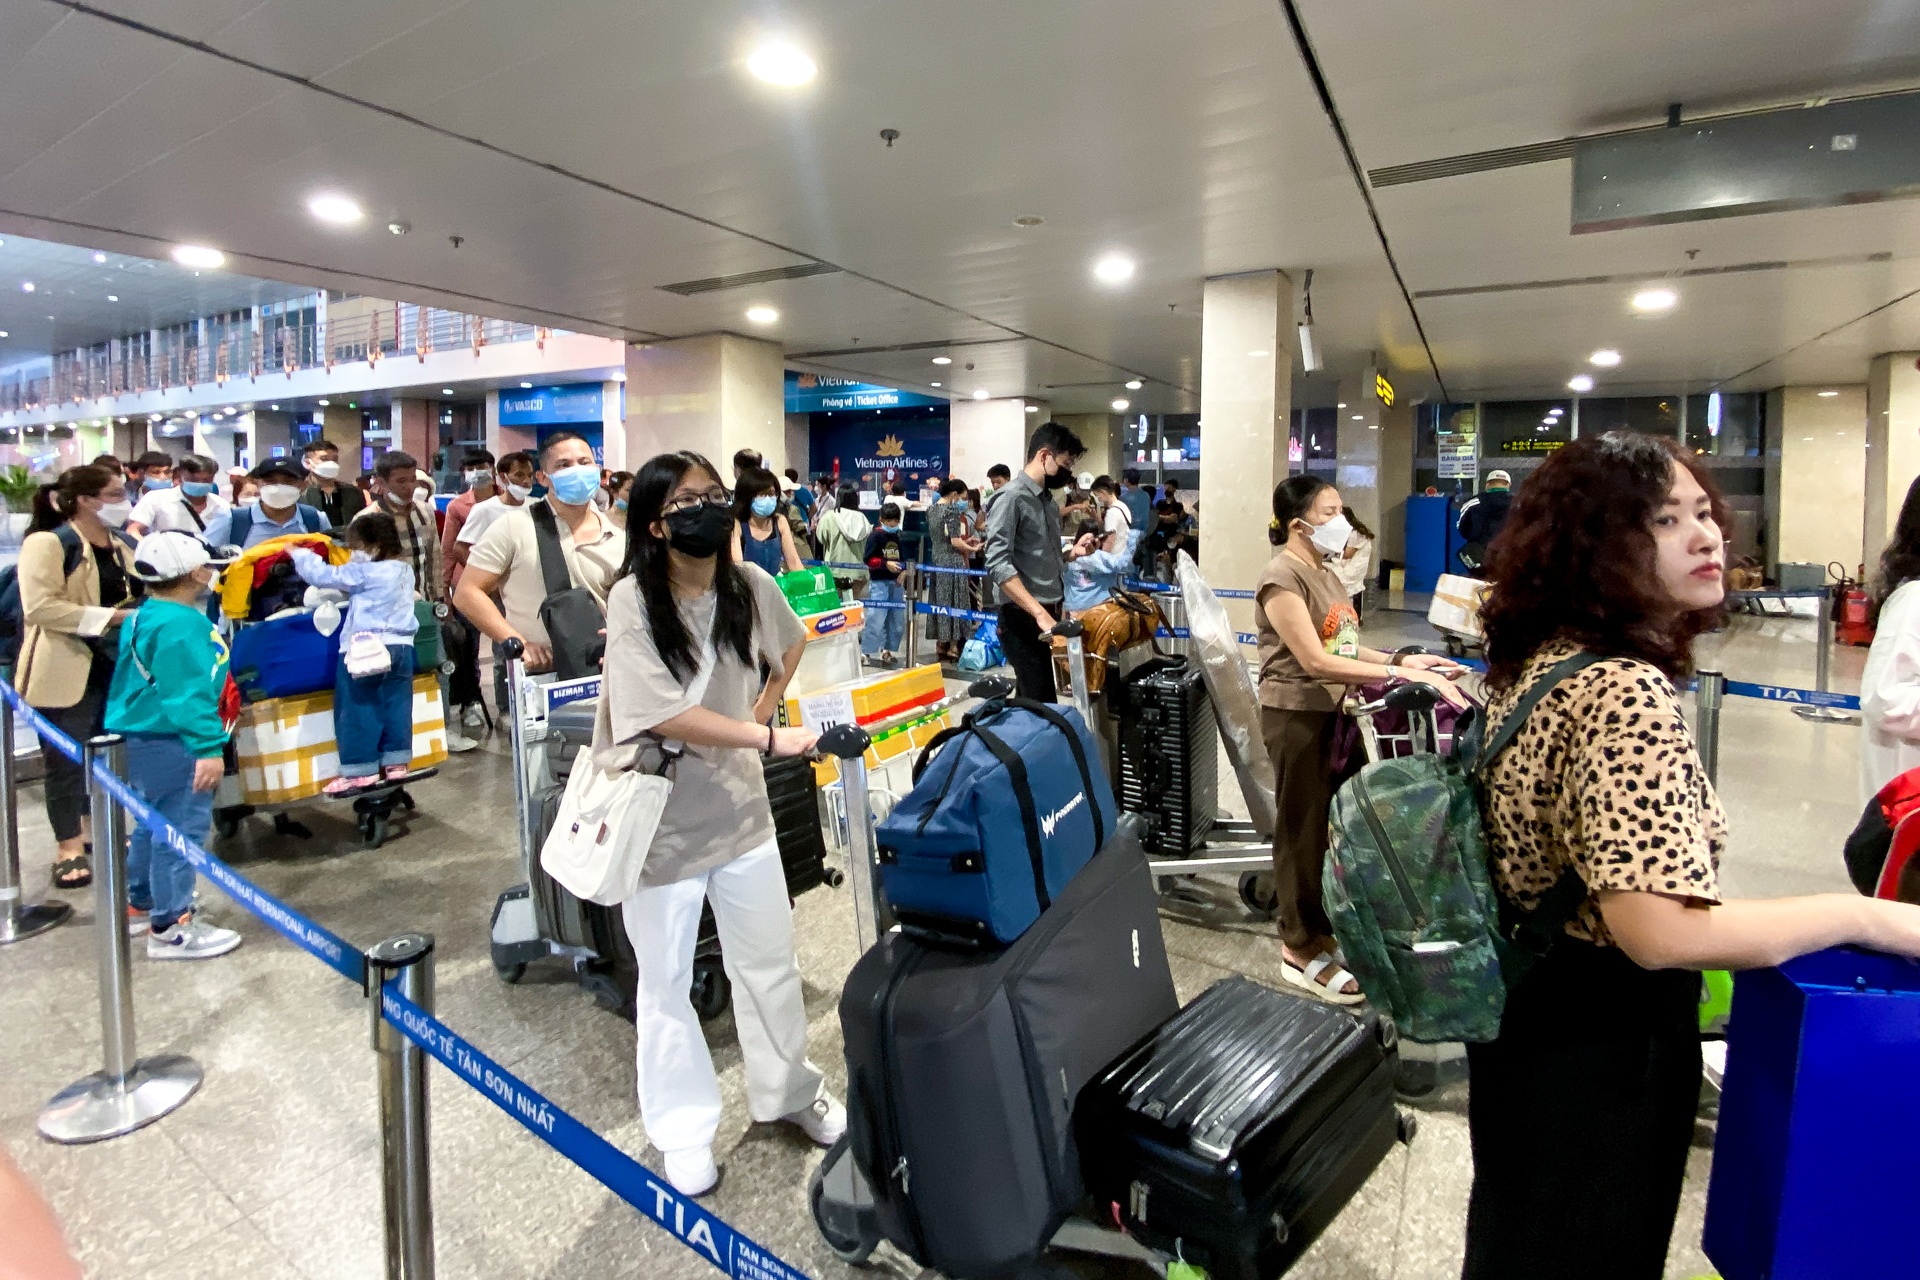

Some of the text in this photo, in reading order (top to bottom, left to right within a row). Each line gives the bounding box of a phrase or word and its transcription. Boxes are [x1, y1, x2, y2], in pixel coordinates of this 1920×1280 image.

[515, 398, 543, 411] VASCO
[857, 394, 877, 406] Ticket
[878, 393, 899, 405] Office
[930, 605, 948, 615] TIA
[553, 686, 583, 699] BIZMAN
[1758, 686, 1802, 701] TIA
[165, 823, 187, 856] TIA
[253, 893, 307, 940] INTERNATIONAL
[404, 1010, 437, 1047] QUỐC
[439, 1035, 456, 1061] TẾ
[456, 1048, 482, 1082] TÂN
[484, 1069, 514, 1106] SƠN
[517, 1092, 556, 1134] NHẤT
[646, 1179, 723, 1265] TIA
[739, 1241, 760, 1265] TAN
